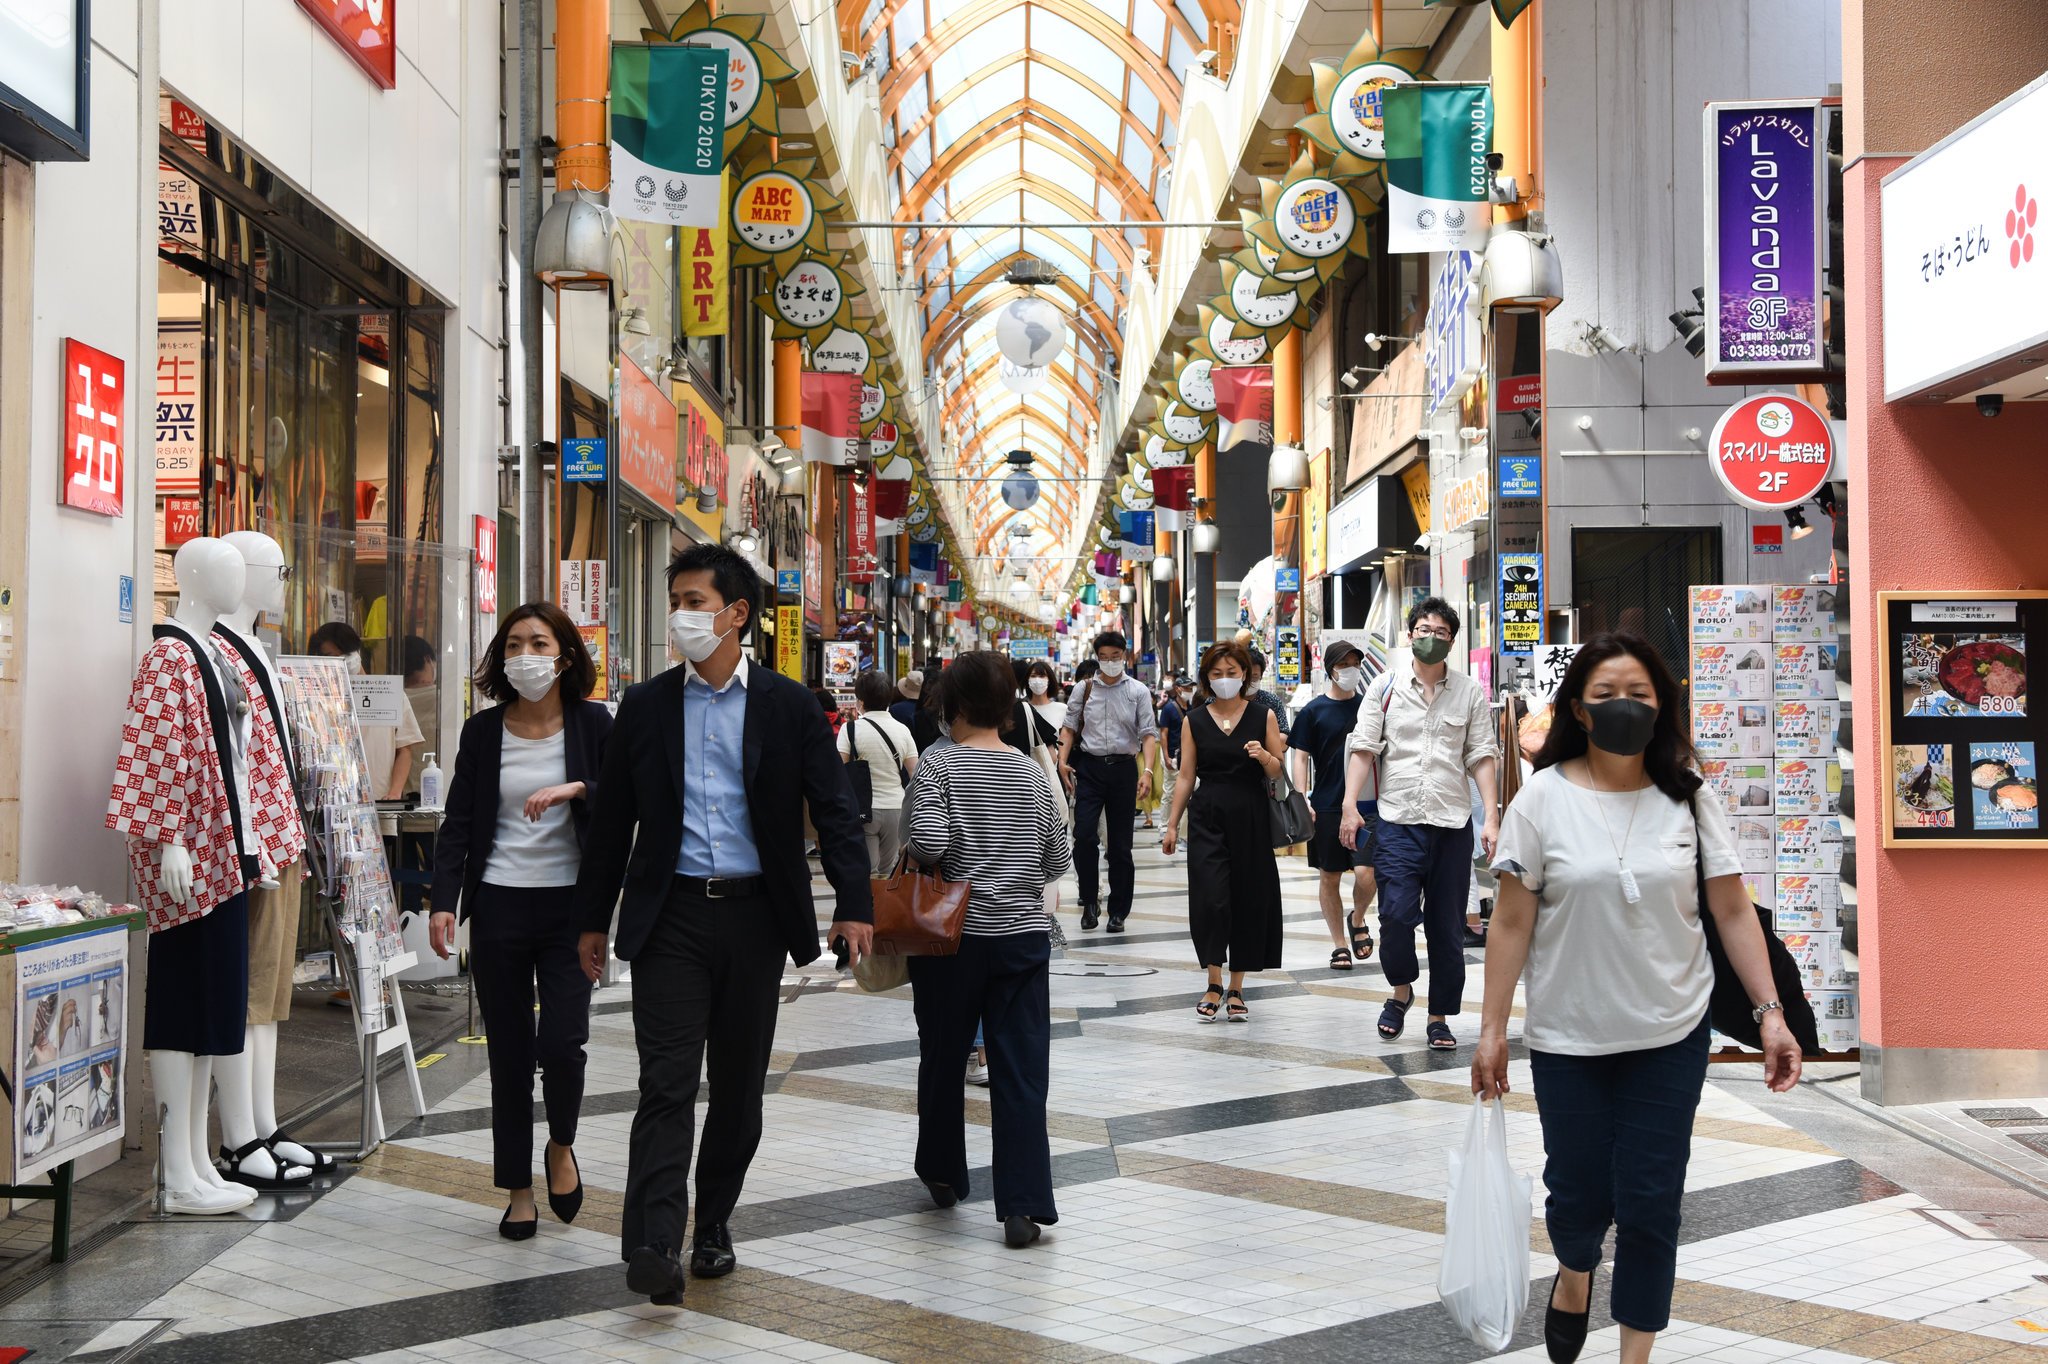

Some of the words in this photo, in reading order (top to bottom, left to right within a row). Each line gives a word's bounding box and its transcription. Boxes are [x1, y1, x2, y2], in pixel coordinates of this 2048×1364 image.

[699, 63, 717, 122] TOKYO
[1470, 99, 1486, 152] TOKYO
[1722, 115, 1809, 148] リラックスサロン
[696, 125, 714, 168] 2020
[1470, 156, 1485, 196] 2020
[752, 187, 793, 206] ABC
[1290, 190, 1339, 218] CYBER
[1750, 133, 1780, 292] Lavanda
[751, 209, 792, 222] MART
[1294, 207, 1336, 225] SLOT
[1921, 223, 1990, 284] そば・うどん
[778, 285, 836, 302] 富士そば
[1748, 297, 1787, 329] 3F
[157, 356, 196, 396] 生
[76, 363, 117, 428] ユニ
[156, 402, 196, 441] 祭
[73, 432, 117, 494] クロ
[157, 447, 195, 456] RSARY
[1722, 441, 1826, 464] スマイリー株式会社
[1757, 471, 1789, 492] 2F
[479, 527, 494, 562] UNI
[1502, 556, 1538, 565] WARNING!
[478, 566, 494, 605] QLO
[570, 562, 580, 591] 送水口
[591, 563, 600, 620] 防犯カメラ設置
[1514, 584, 1528, 593] 24H
[1504, 593, 1538, 602] SECURITY
[1504, 601, 1538, 610] CAMERAS
[790, 610, 798, 655] 自転車から
[1505, 624, 1537, 632] 防犯カメラ
